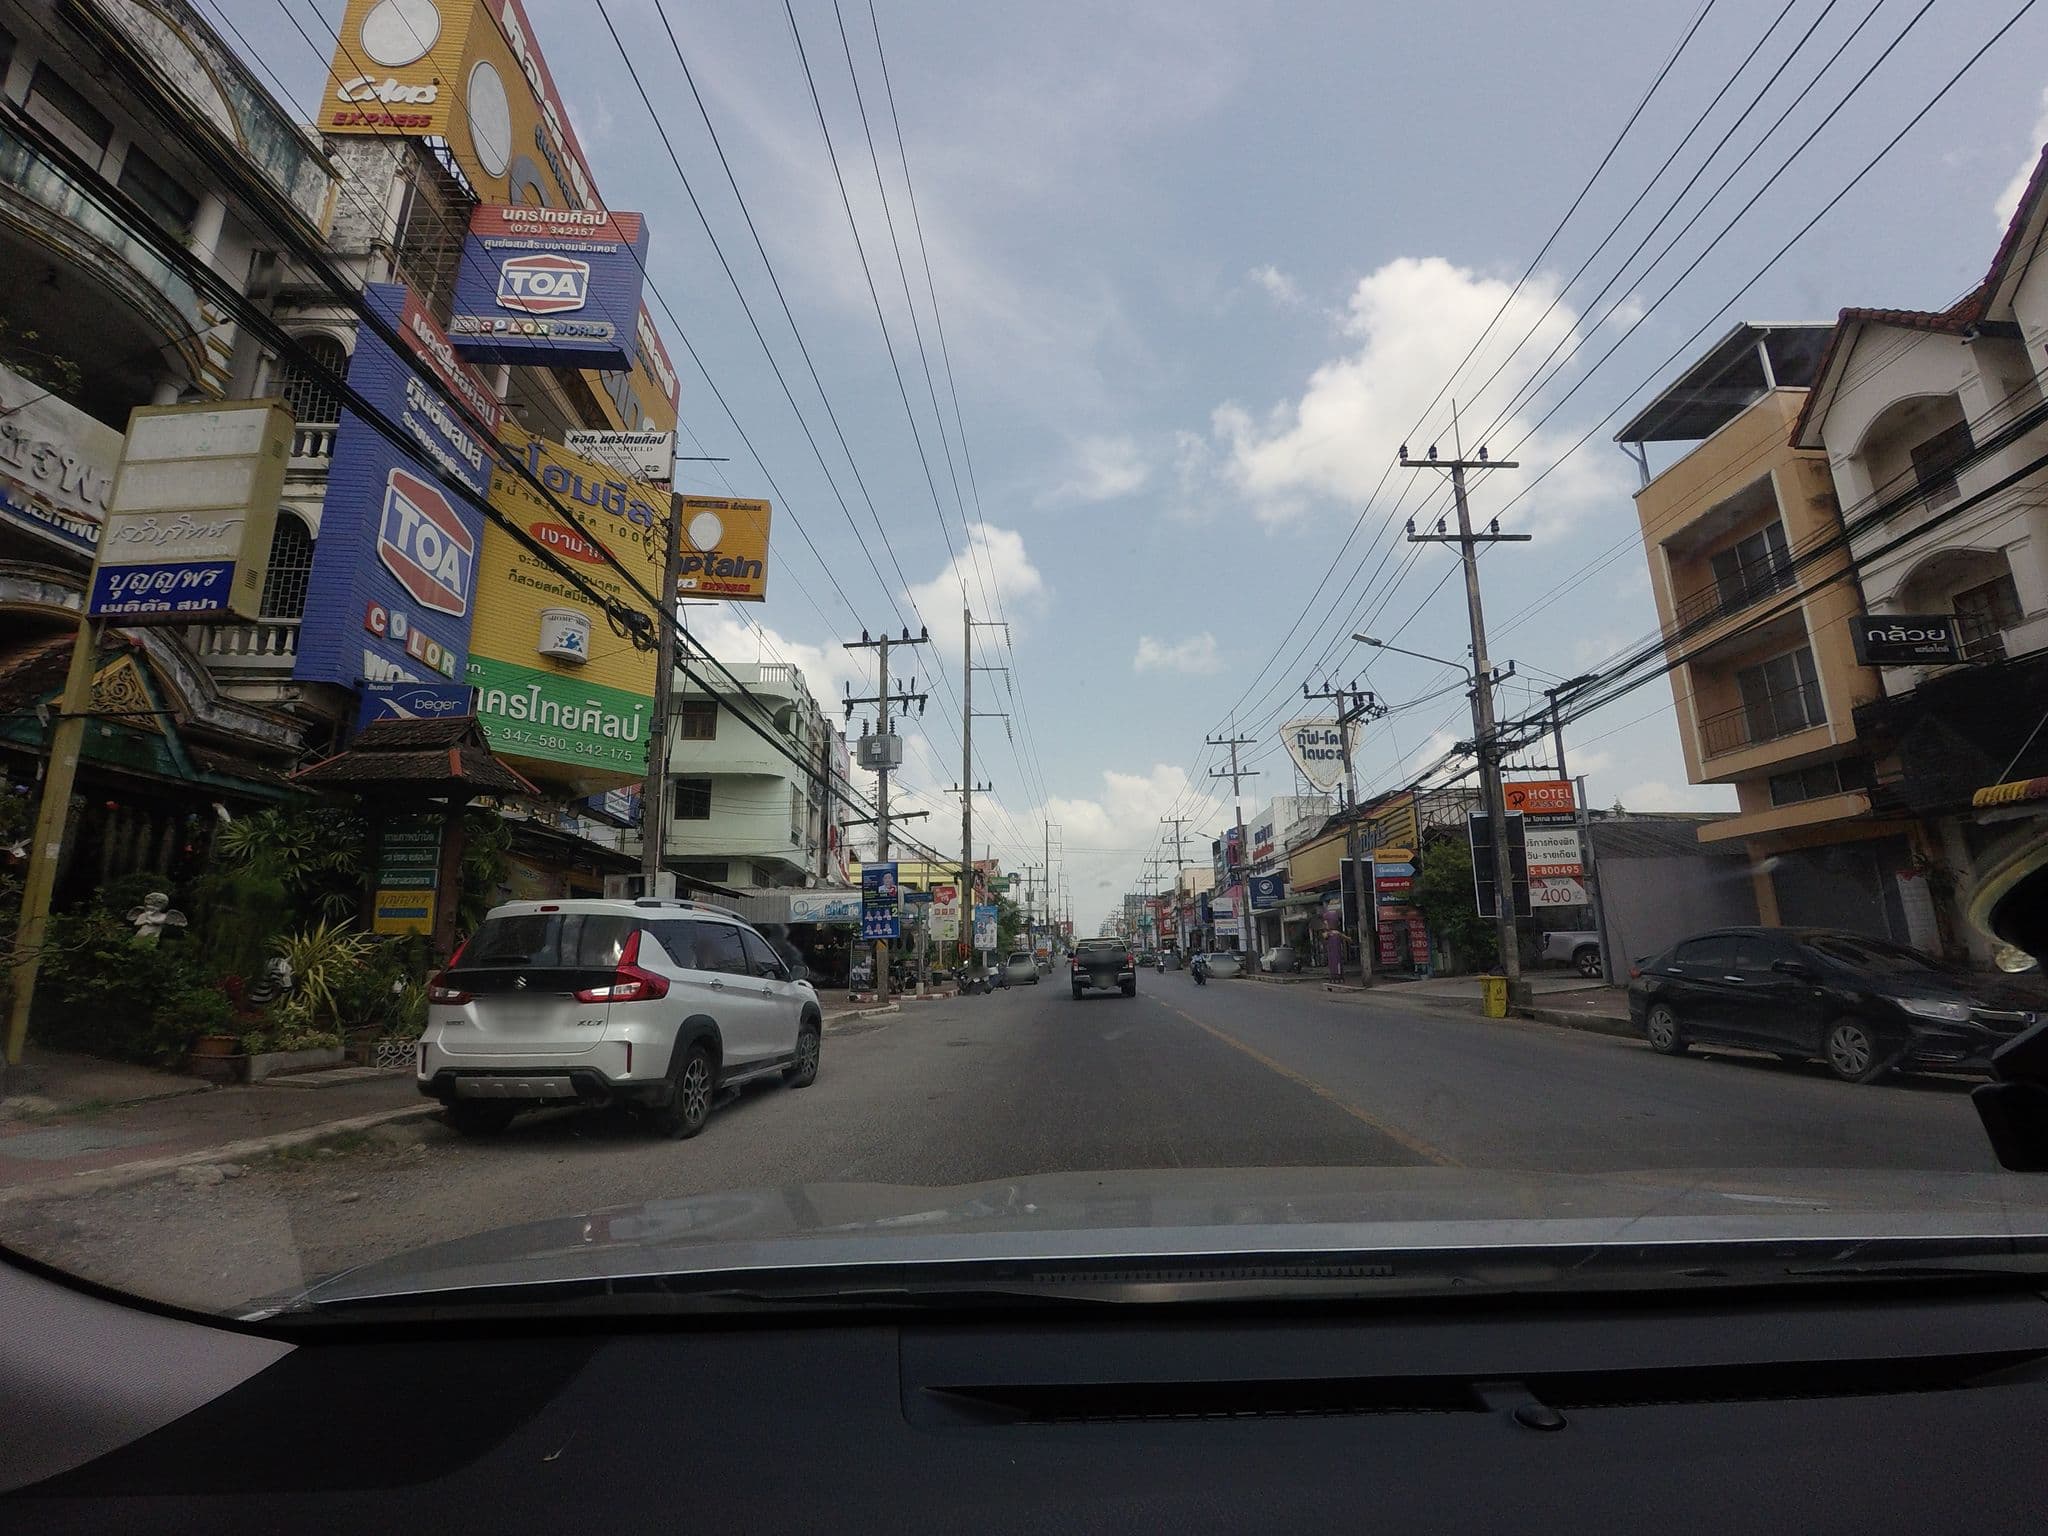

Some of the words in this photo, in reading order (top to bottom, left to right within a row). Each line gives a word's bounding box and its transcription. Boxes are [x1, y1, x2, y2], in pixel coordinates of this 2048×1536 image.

[332, 112, 432, 127] EXPRESS
[502, 208, 608, 226] นครไทยศิลป์
[510, 224, 543, 235] (075)
[508, 271, 578, 297] TOA
[480, 319, 550, 336] COLOR
[553, 322, 608, 337] WORLD
[394, 503, 463, 596] TOA
[108, 569, 225, 600] บุญญพร
[100, 598, 171, 614] เมดิคัล
[177, 597, 218, 611] สปา
[370, 606, 456, 676] COLOR
[1867, 625, 1946, 642] กล้วย
[415, 698, 462, 712] beger
[575, 741, 632, 761] 342-175
[1528, 789, 1571, 800] HOTEL
[1527, 849, 1577, 860] วัน-รายเดือน
[1530, 865, 1579, 875] 5-800495
[1540, 888, 1571, 903] 400
